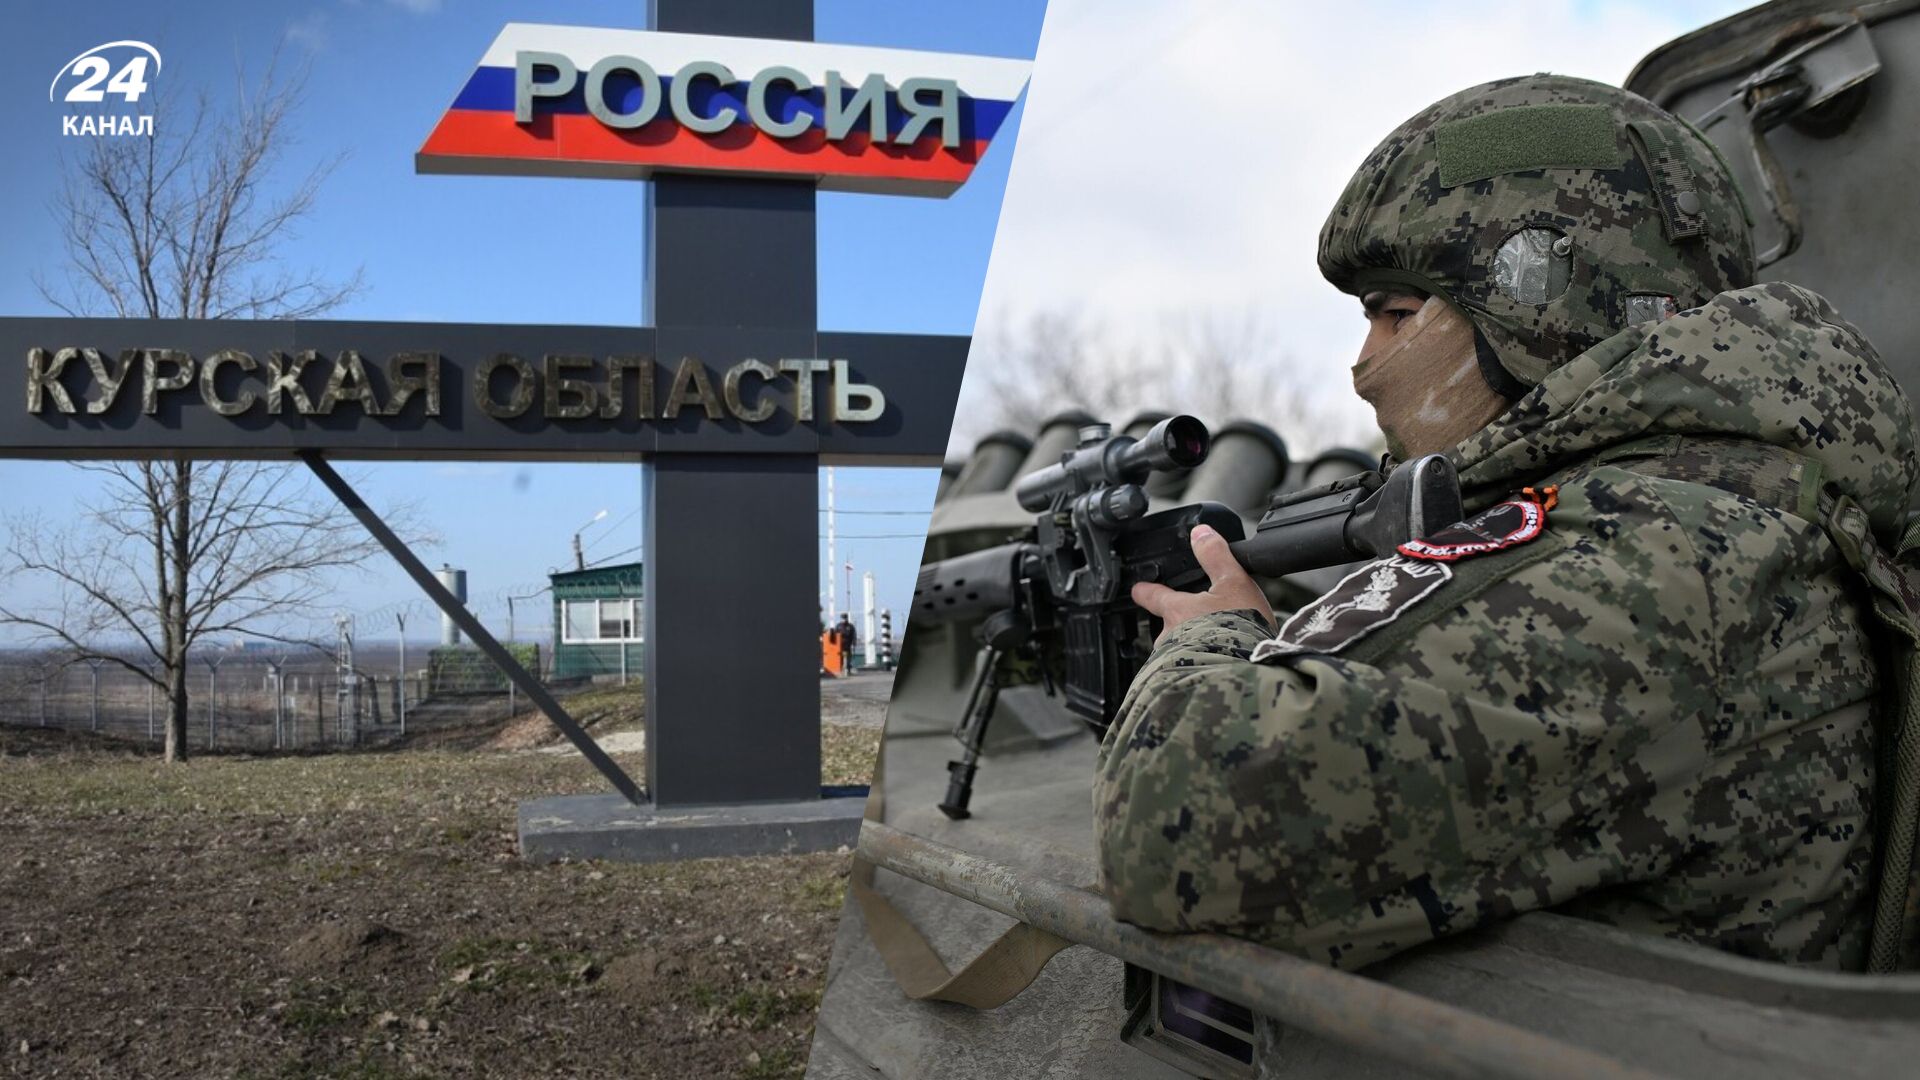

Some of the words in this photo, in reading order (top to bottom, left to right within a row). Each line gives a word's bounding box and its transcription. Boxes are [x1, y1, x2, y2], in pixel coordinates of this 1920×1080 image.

[515, 50, 960, 149] РОССИЯ
[27, 346, 441, 416] КУРСКАЯ
[473, 352, 886, 423] ОБЛАСТЬ
